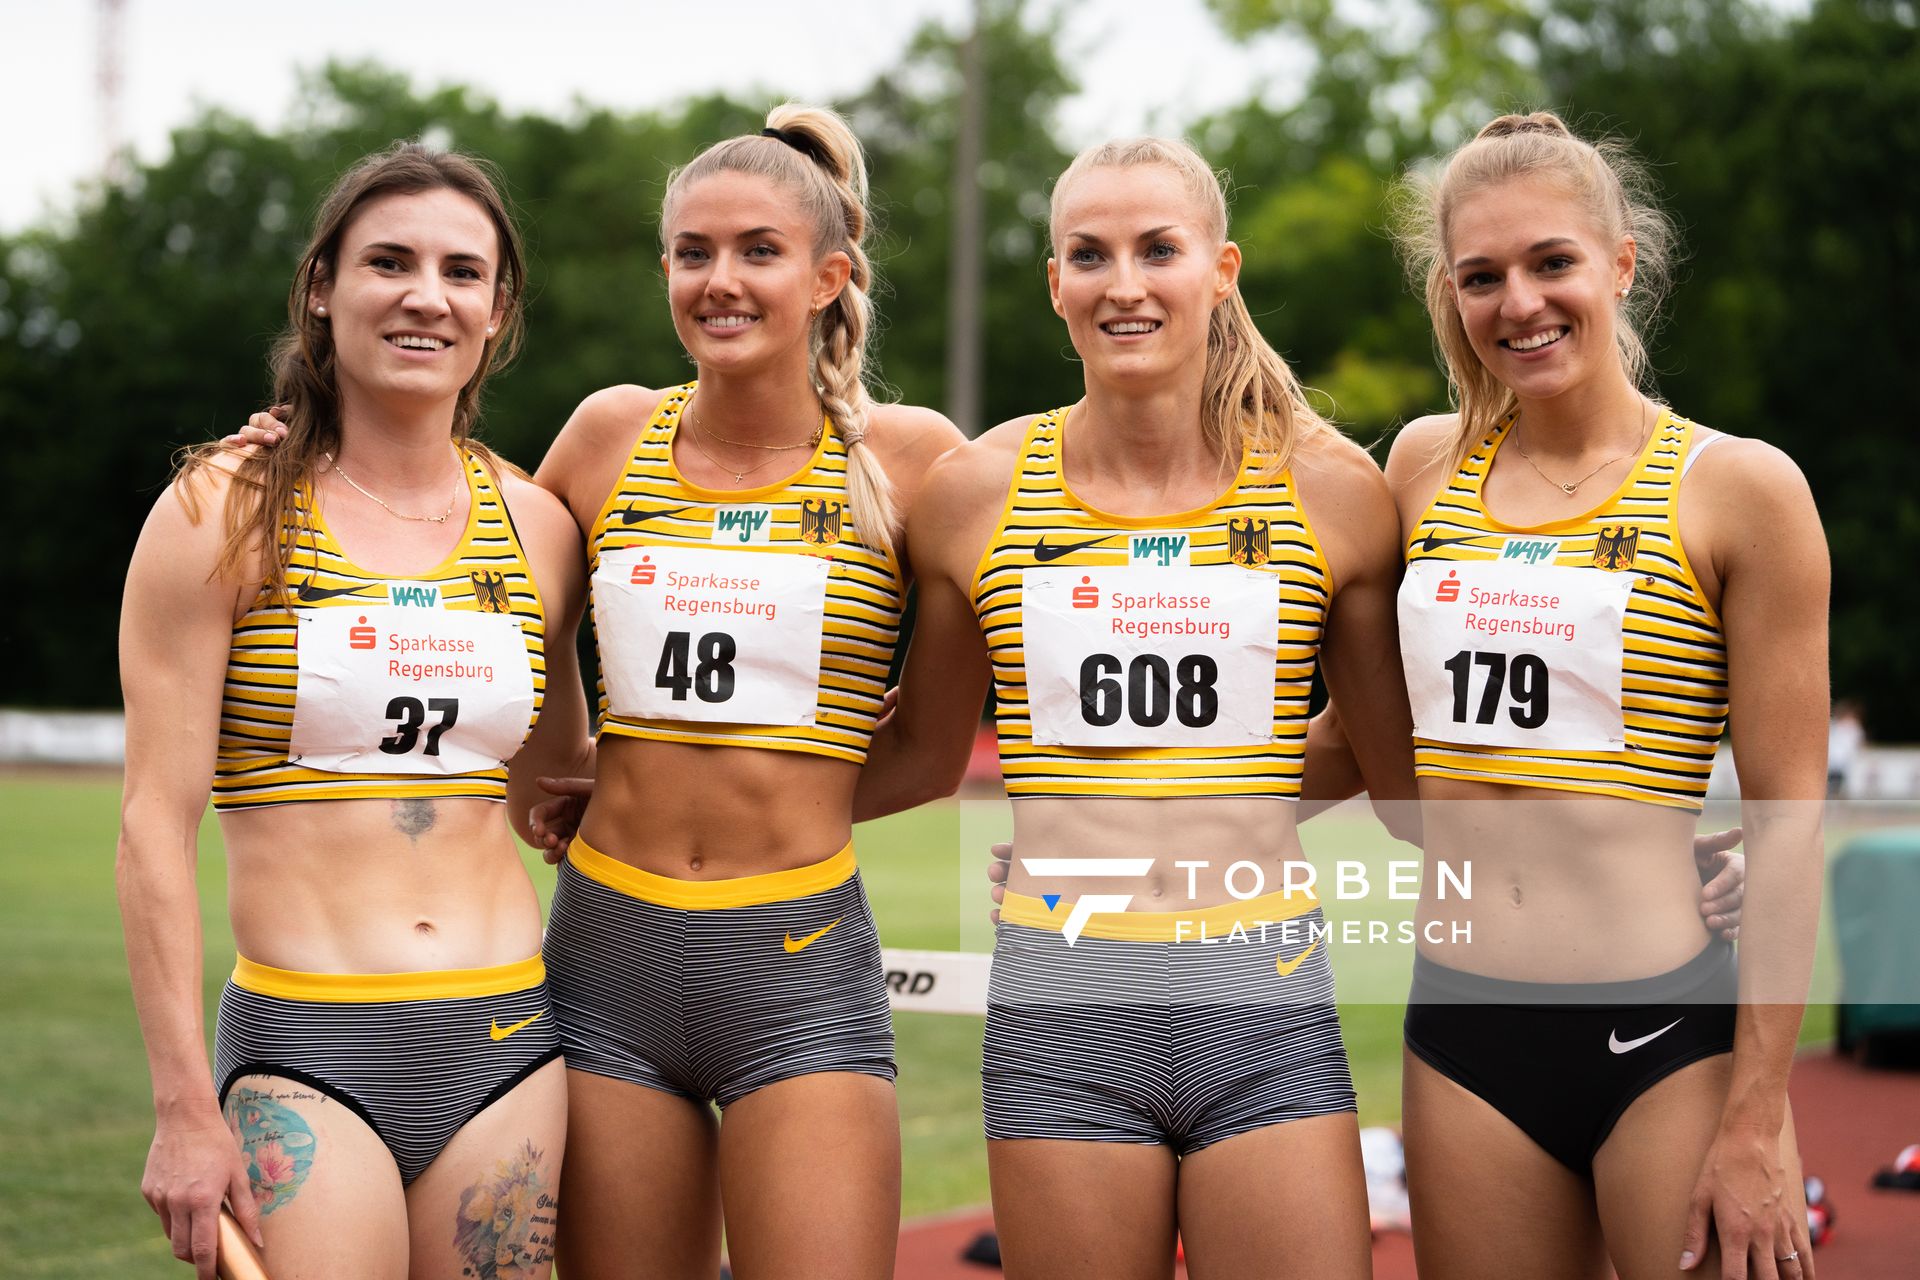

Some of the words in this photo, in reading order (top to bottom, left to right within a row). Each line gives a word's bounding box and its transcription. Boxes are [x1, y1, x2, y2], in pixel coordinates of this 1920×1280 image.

[666, 571, 760, 591] Sparkasse
[664, 594, 776, 621] Regensburg
[1111, 592, 1211, 612] Sparkasse
[1468, 587, 1560, 609] Sparkasse
[1111, 616, 1231, 640] Regensburg
[1465, 612, 1576, 642] Regensburg
[389, 633, 475, 655] Sparkasse
[388, 659, 494, 683] Regensburg
[654, 631, 737, 703] 48
[1079, 653, 1219, 728] 608
[1444, 650, 1549, 730] 179
[378, 696, 459, 757] 37
